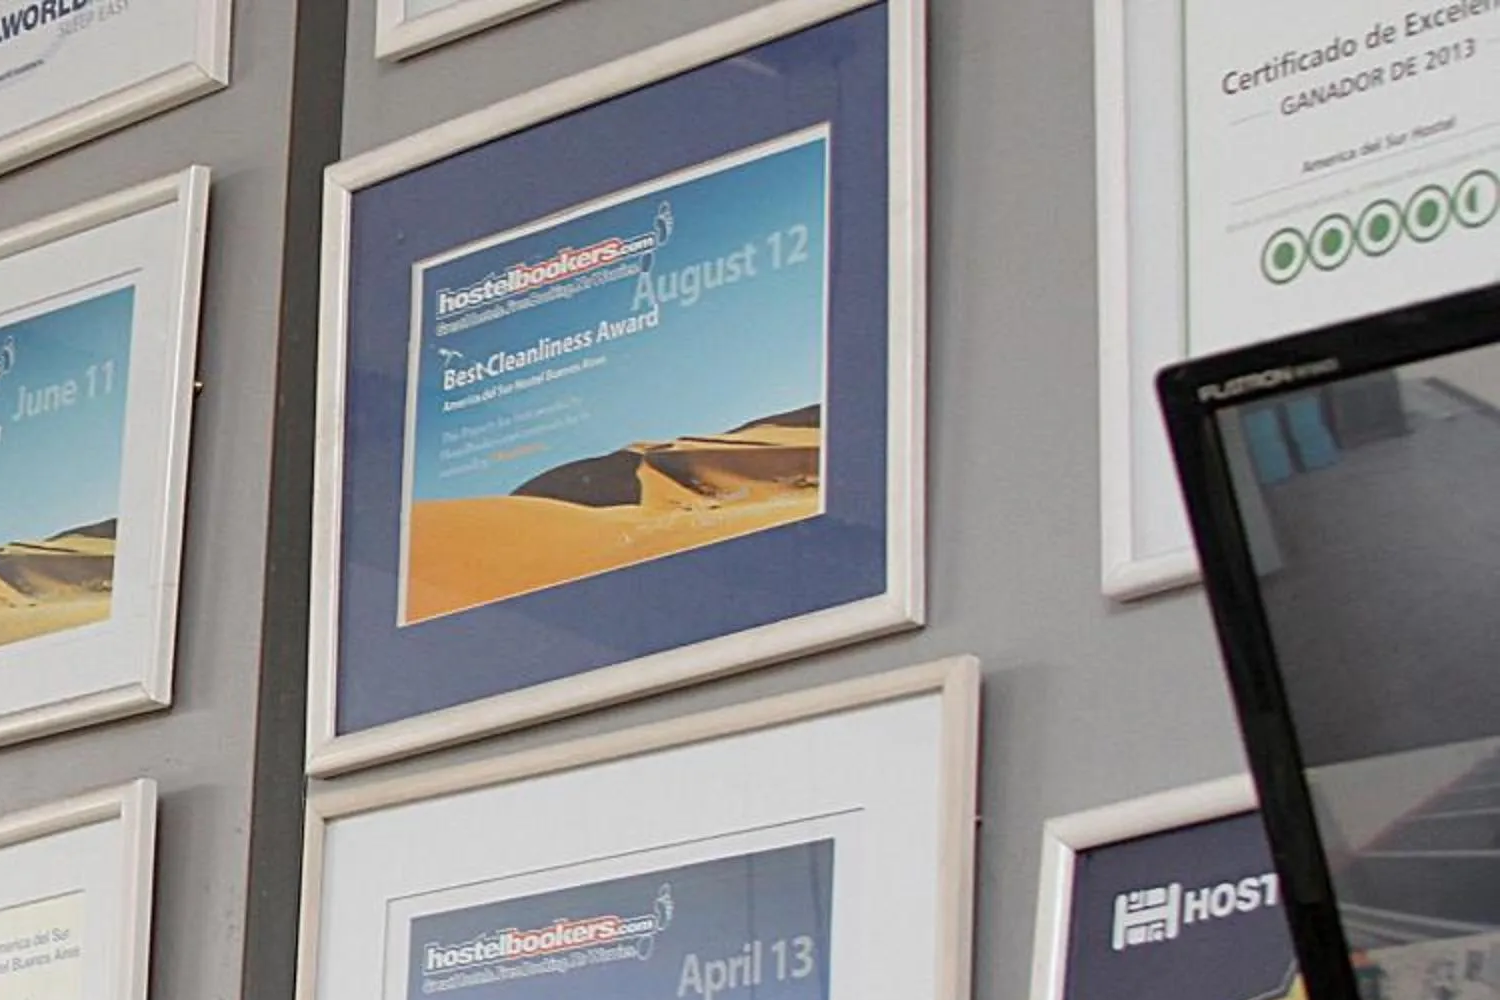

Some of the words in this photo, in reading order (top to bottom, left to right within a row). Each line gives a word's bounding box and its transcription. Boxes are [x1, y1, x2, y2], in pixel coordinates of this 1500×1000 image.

[1220, 36, 1359, 96] Certificado
[1364, 22, 1398, 49] de
[1280, 66, 1386, 116] GANADOR
[1390, 56, 1418, 82] DE
[1424, 37, 1477, 71] 2013
[438, 236, 656, 316] hostelbookers.com
[631, 243, 757, 312] August
[766, 223, 808, 271] 12
[444, 361, 484, 391] Best
[486, 327, 592, 377] Cleanliness
[595, 303, 660, 343] Award
[10, 379, 78, 421] June
[86, 358, 117, 400] 11
[426, 918, 655, 970] hostelbookers.com
[771, 935, 814, 982] 13
